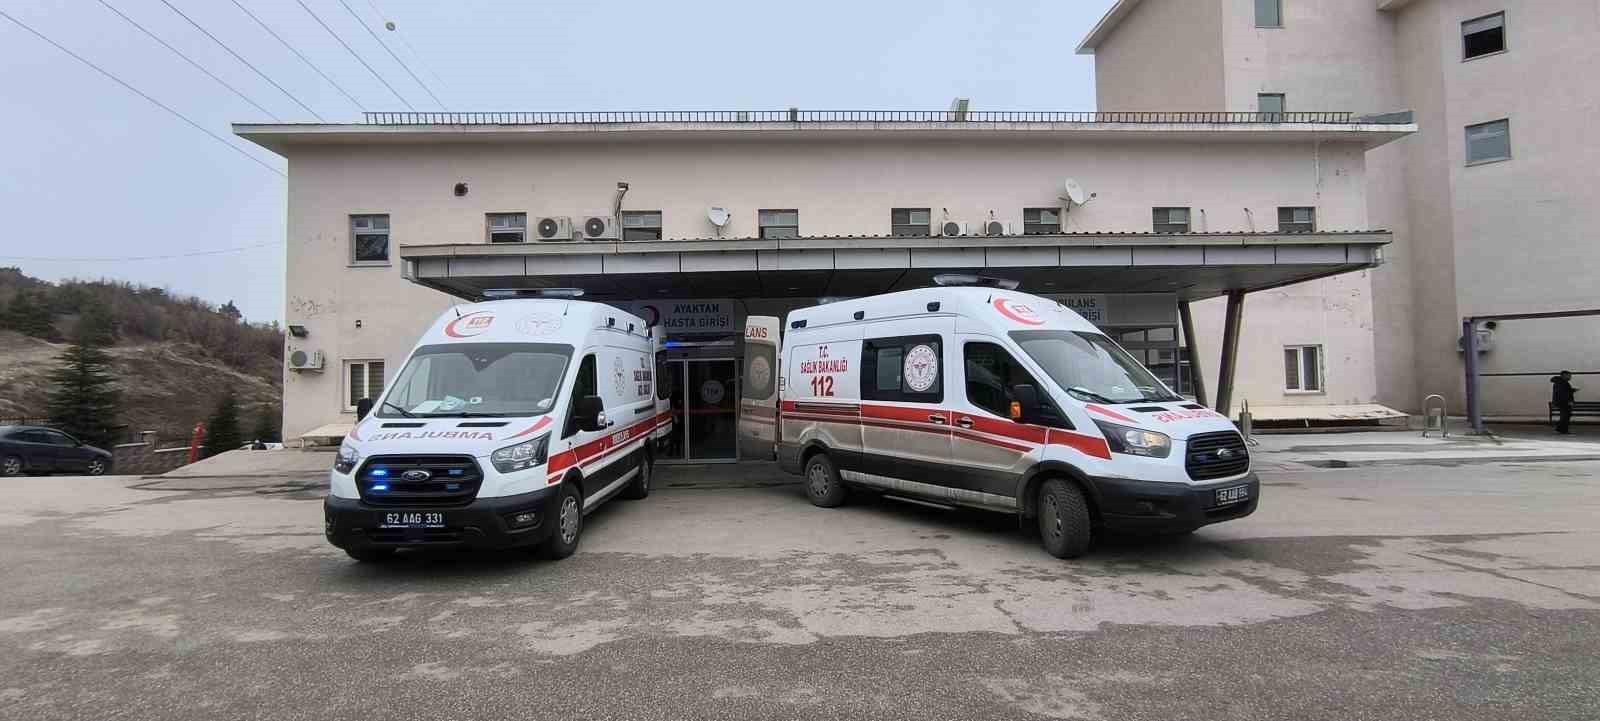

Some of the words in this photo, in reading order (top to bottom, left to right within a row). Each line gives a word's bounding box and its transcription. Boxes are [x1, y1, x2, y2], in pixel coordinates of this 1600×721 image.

[673, 303, 719, 313] AYAKTAN
[663, 318, 695, 328] HASTA
[811, 375, 834, 397] 112
[386, 512, 400, 524] 62
[402, 512, 422, 524] AAG
[425, 512, 443, 524] 331
